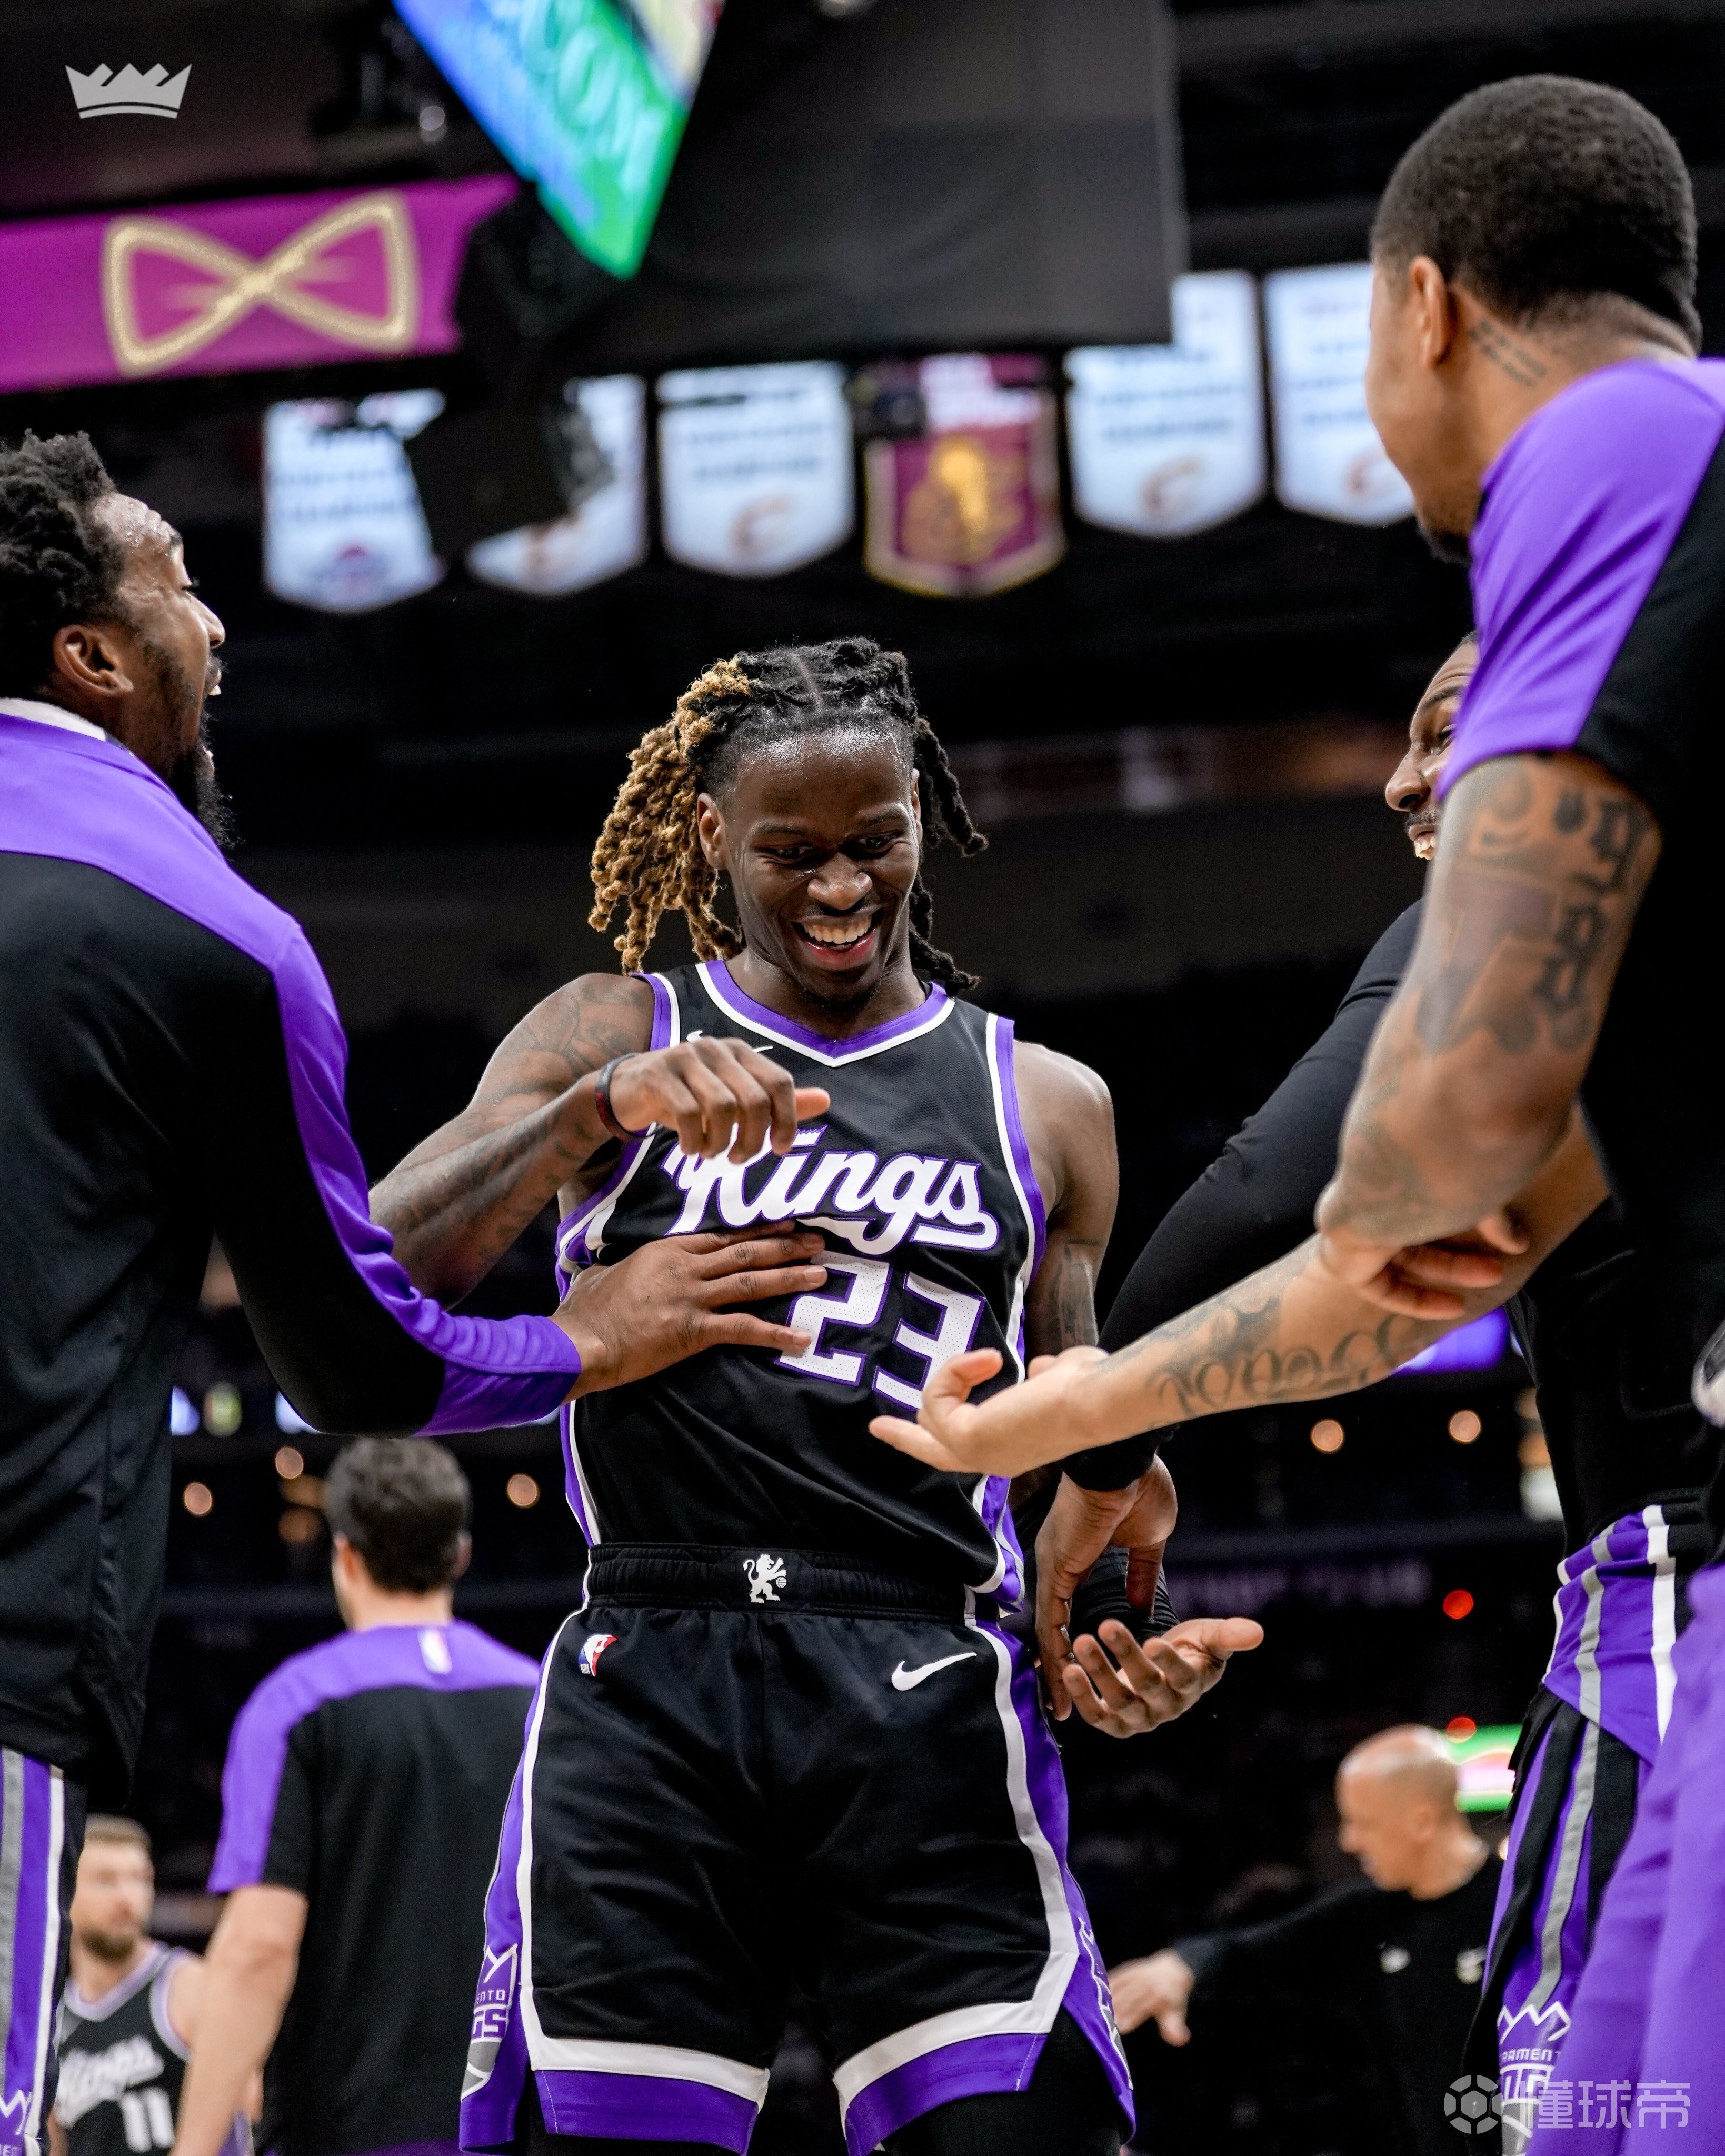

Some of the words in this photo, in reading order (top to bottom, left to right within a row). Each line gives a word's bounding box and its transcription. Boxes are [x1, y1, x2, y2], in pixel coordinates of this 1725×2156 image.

[661, 1123, 1000, 1256] Kings
[775, 1250, 986, 1413] 23
[580, 1663, 591, 1674] NBA
[120, 2088, 175, 2153] 11
